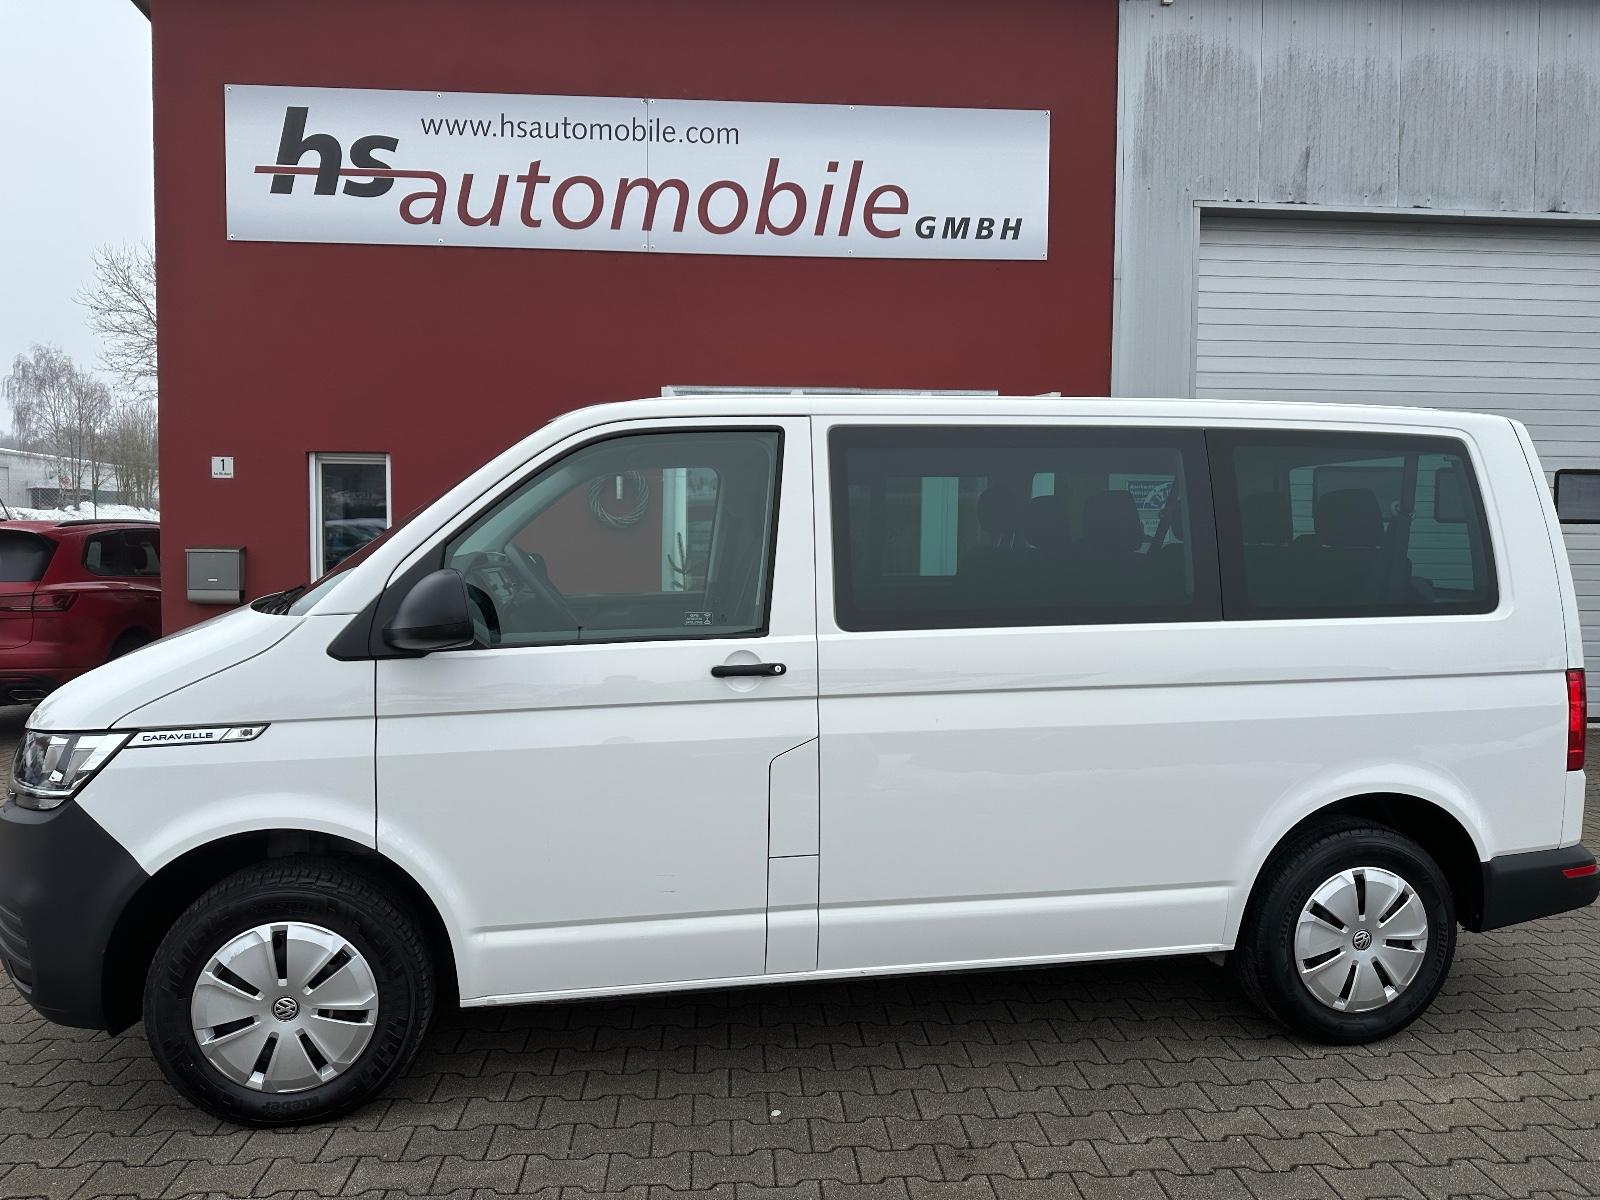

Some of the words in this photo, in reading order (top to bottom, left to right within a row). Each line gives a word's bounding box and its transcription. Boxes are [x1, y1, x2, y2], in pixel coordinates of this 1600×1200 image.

[421, 113, 739, 145] www.hsautomobile.com
[269, 106, 399, 198] hs
[399, 158, 909, 239] automobile
[914, 215, 1023, 241] GMBH
[220, 458, 225, 471] 1
[142, 732, 214, 742] CARAVELLE
